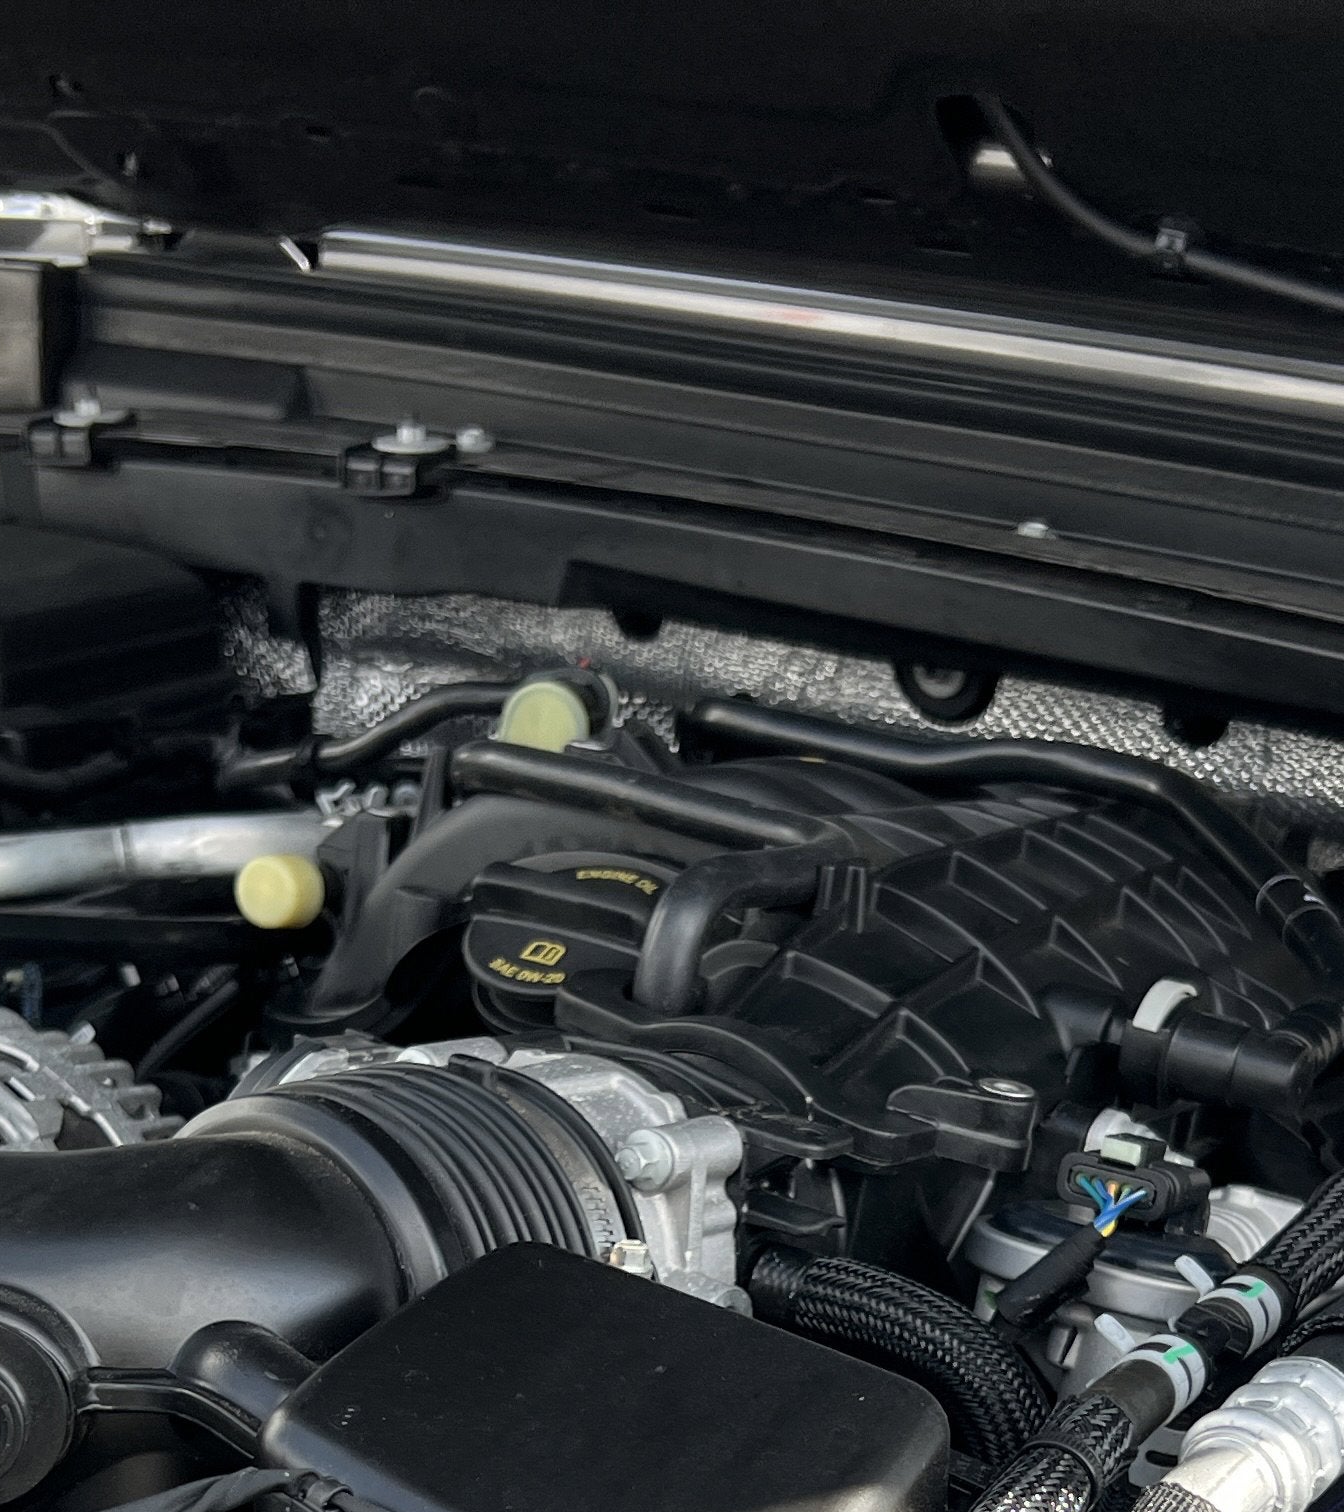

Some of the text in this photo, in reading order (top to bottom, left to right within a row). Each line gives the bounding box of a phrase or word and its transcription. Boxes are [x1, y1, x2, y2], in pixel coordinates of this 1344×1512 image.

[575, 869, 658, 895] ENGINE OIL
[488, 957, 566, 985] SAE 0W-20
